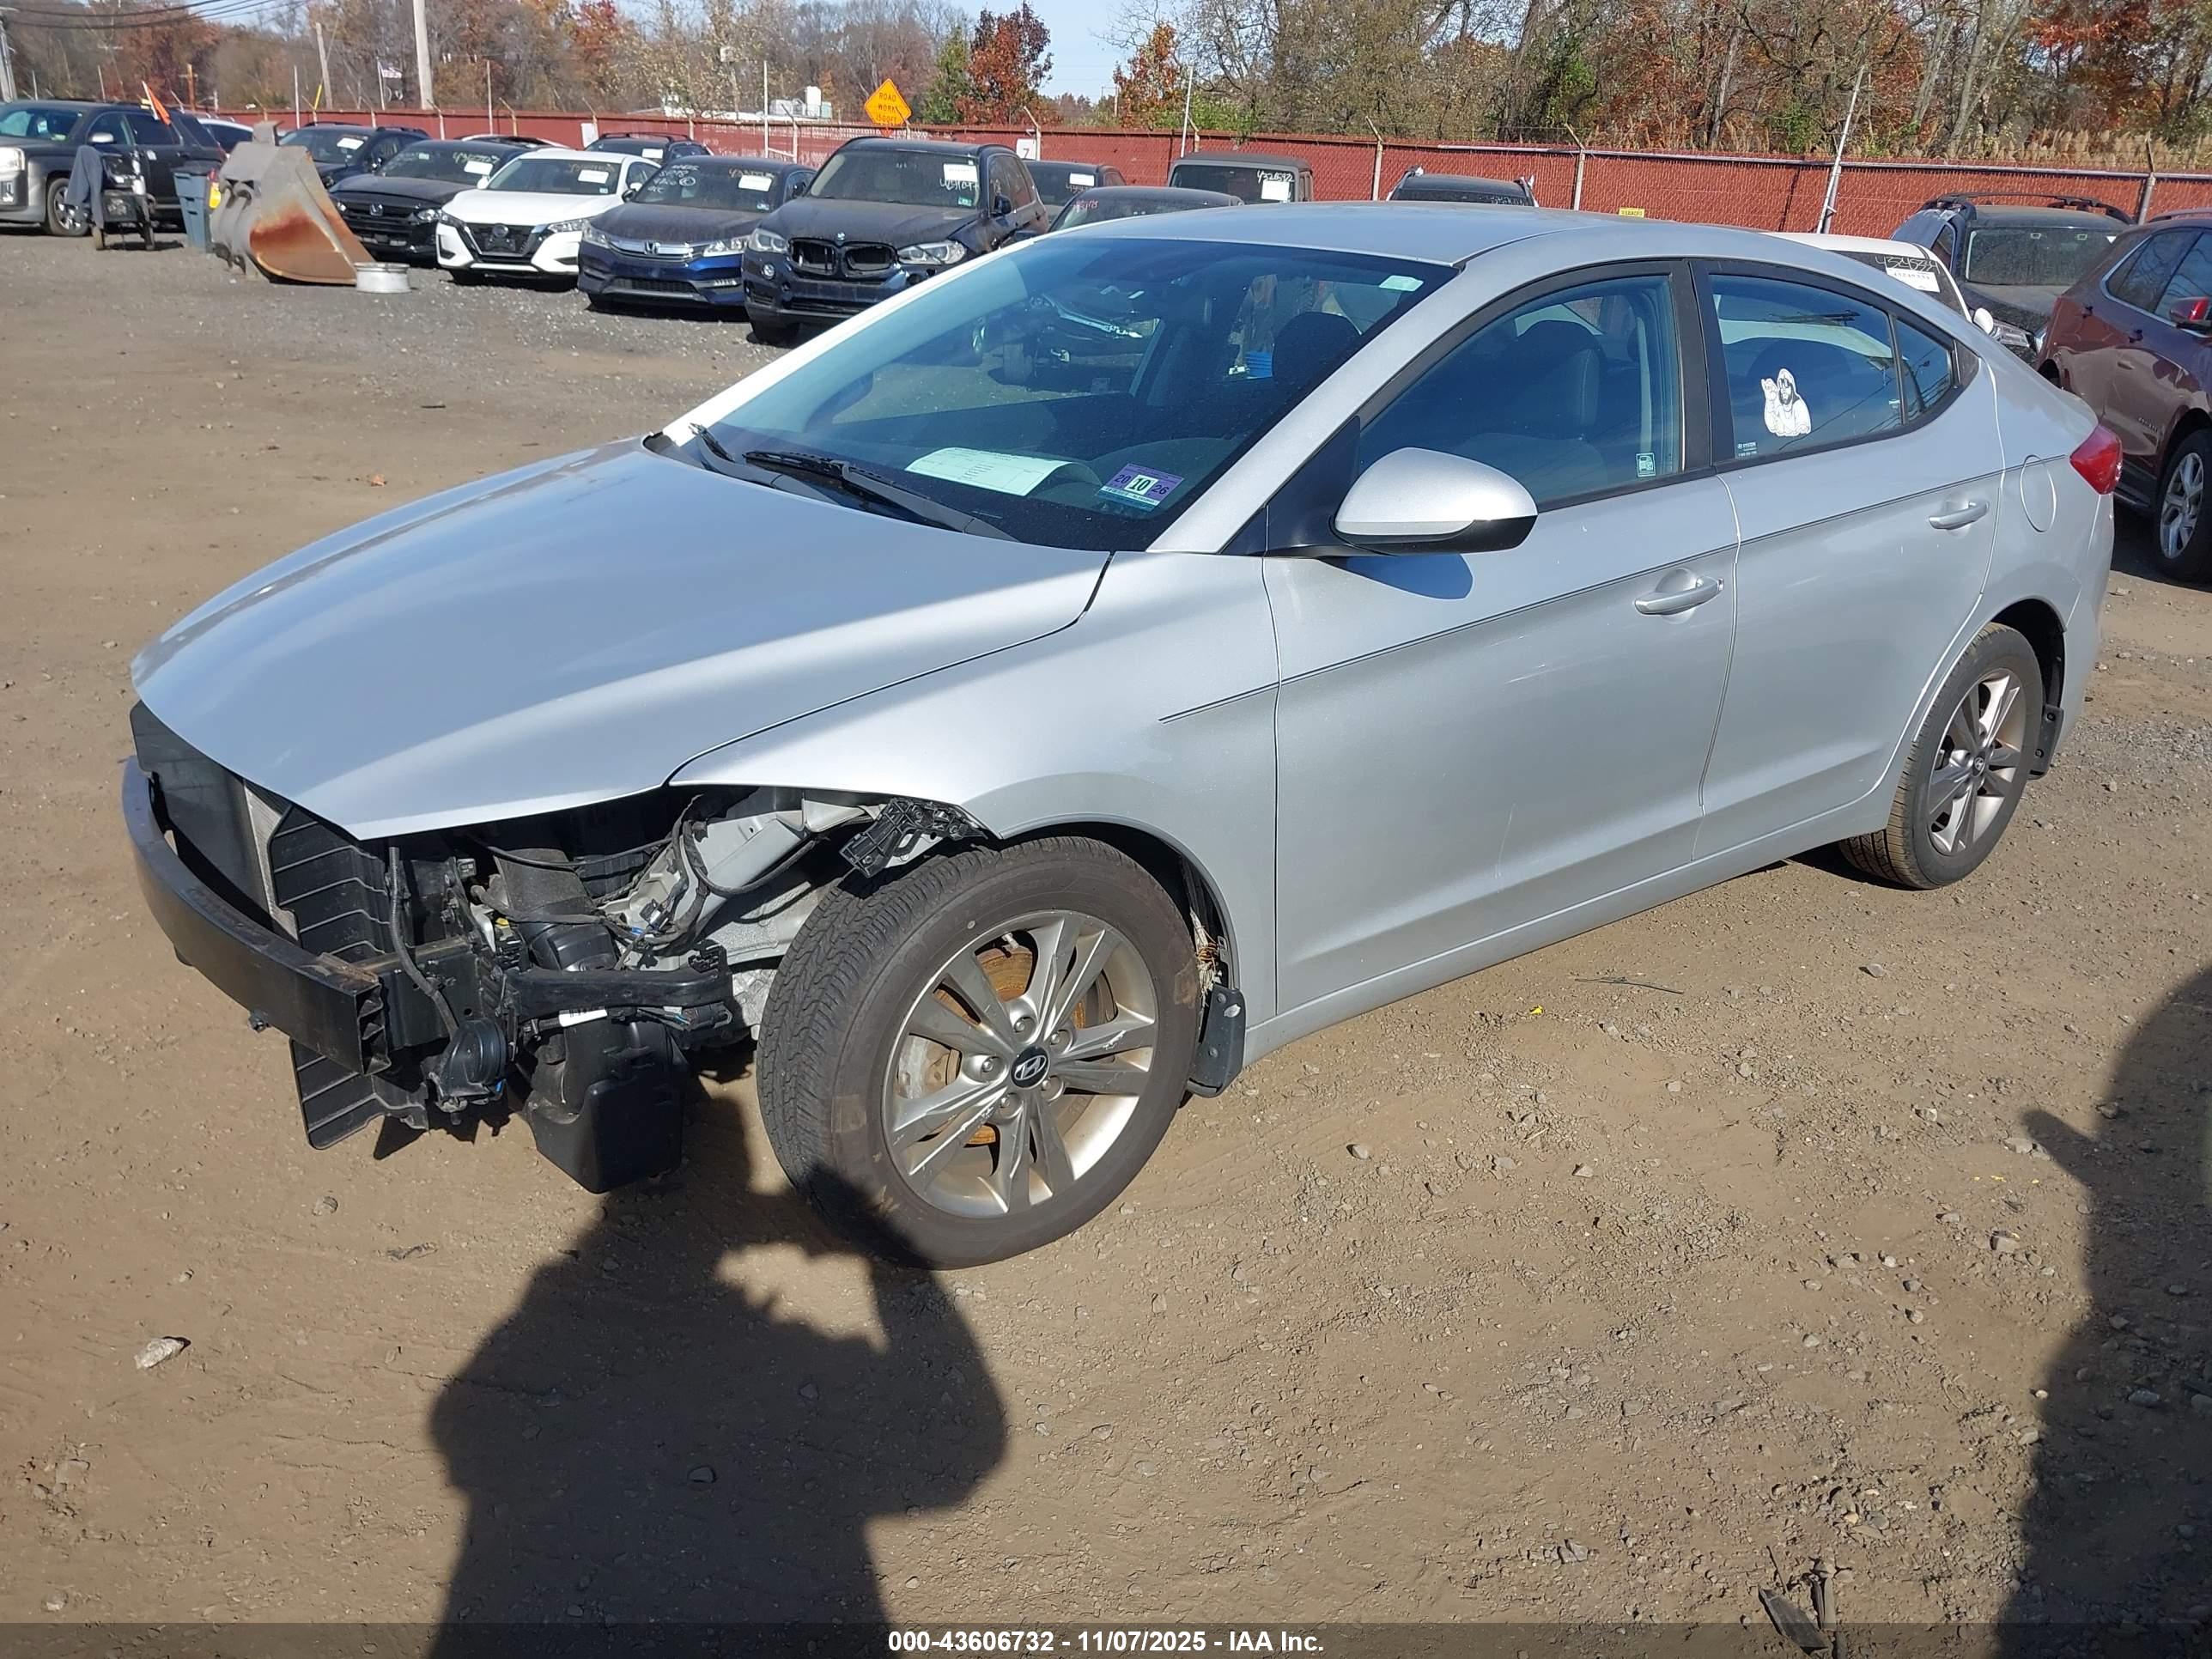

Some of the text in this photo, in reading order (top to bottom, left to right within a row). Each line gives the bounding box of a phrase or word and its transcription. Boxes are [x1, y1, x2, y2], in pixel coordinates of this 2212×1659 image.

[878, 92, 896, 102] ROAD
[878, 103, 896, 113] WORK
[1115, 474, 1132, 484] 20
[1128, 477, 1152, 491] 10
[1151, 484, 1170, 495] 26
